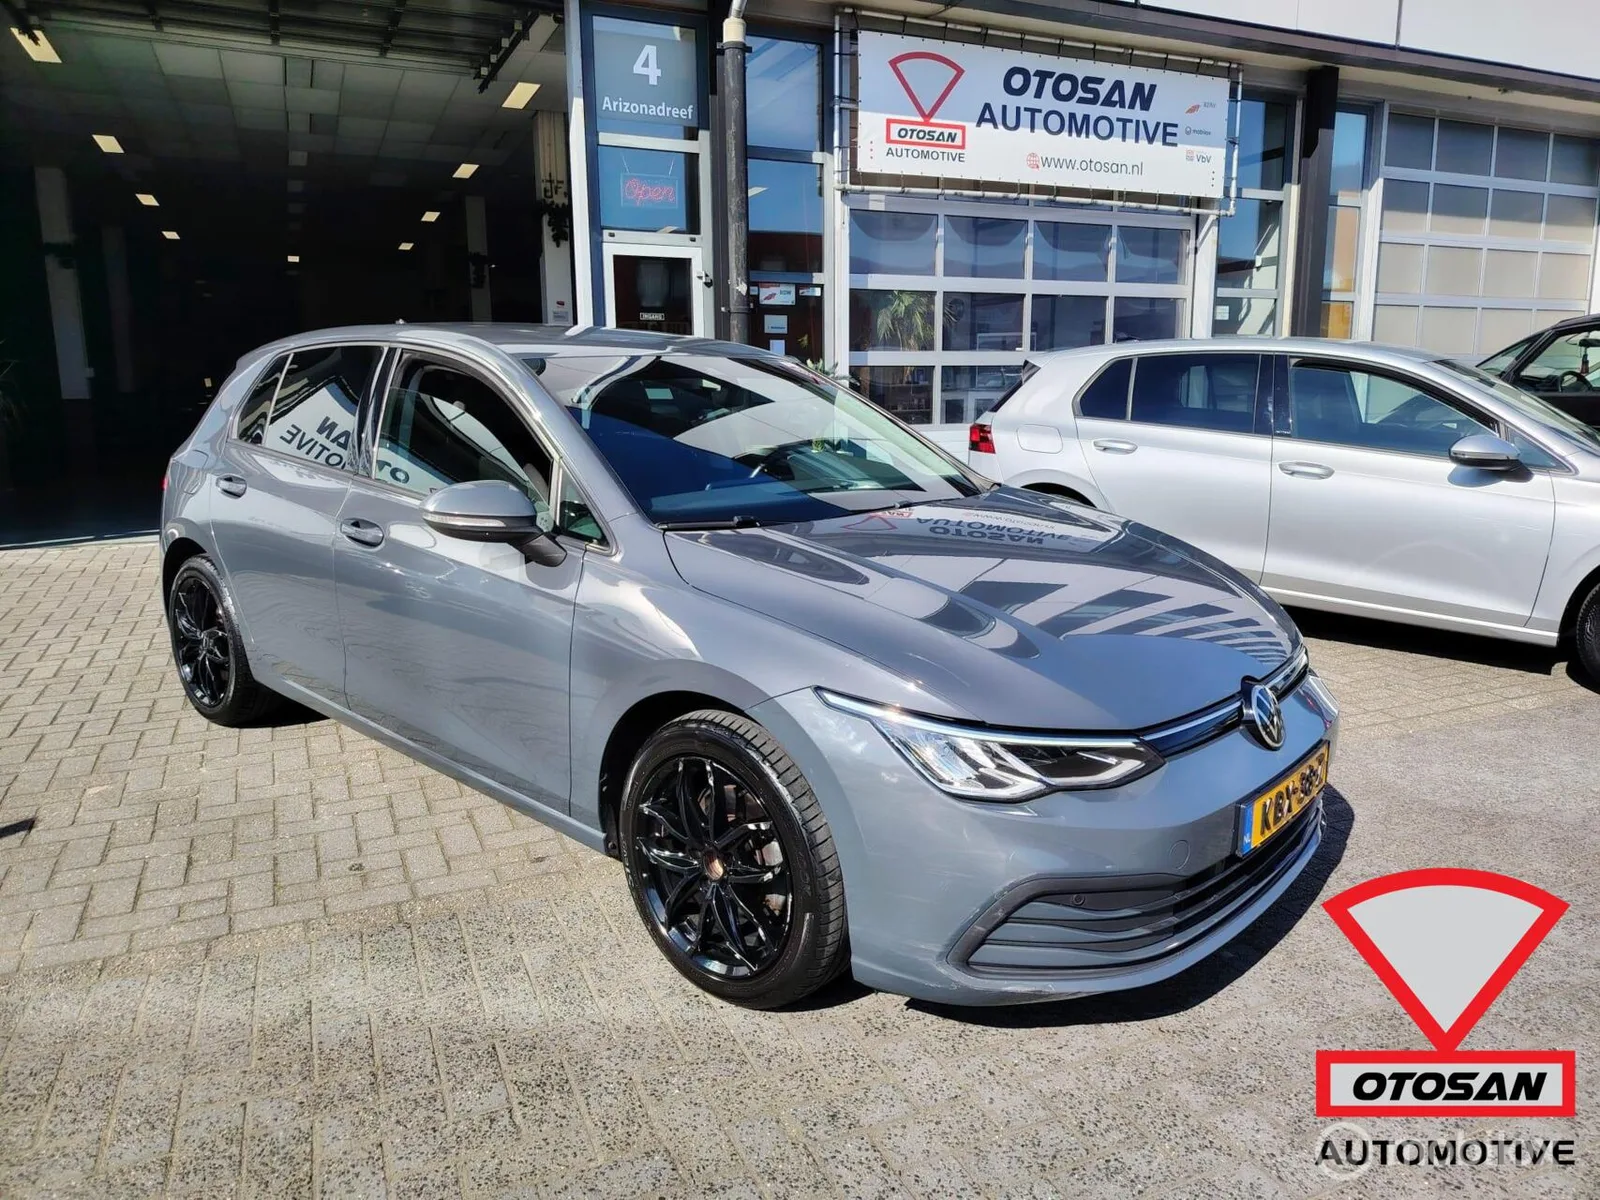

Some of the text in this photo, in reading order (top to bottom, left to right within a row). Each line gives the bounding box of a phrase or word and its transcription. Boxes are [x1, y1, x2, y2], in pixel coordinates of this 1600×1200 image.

[632, 45, 661, 86] 4
[1003, 66, 1157, 112] OTOSAN
[602, 96, 694, 120] Arizonadreef
[897, 127, 958, 143] OTOSAN
[976, 102, 1179, 148] AUTOMOTIVE
[886, 146, 965, 163] AUTOMOTIVE
[1041, 155, 1144, 176] www.otosan.nl
